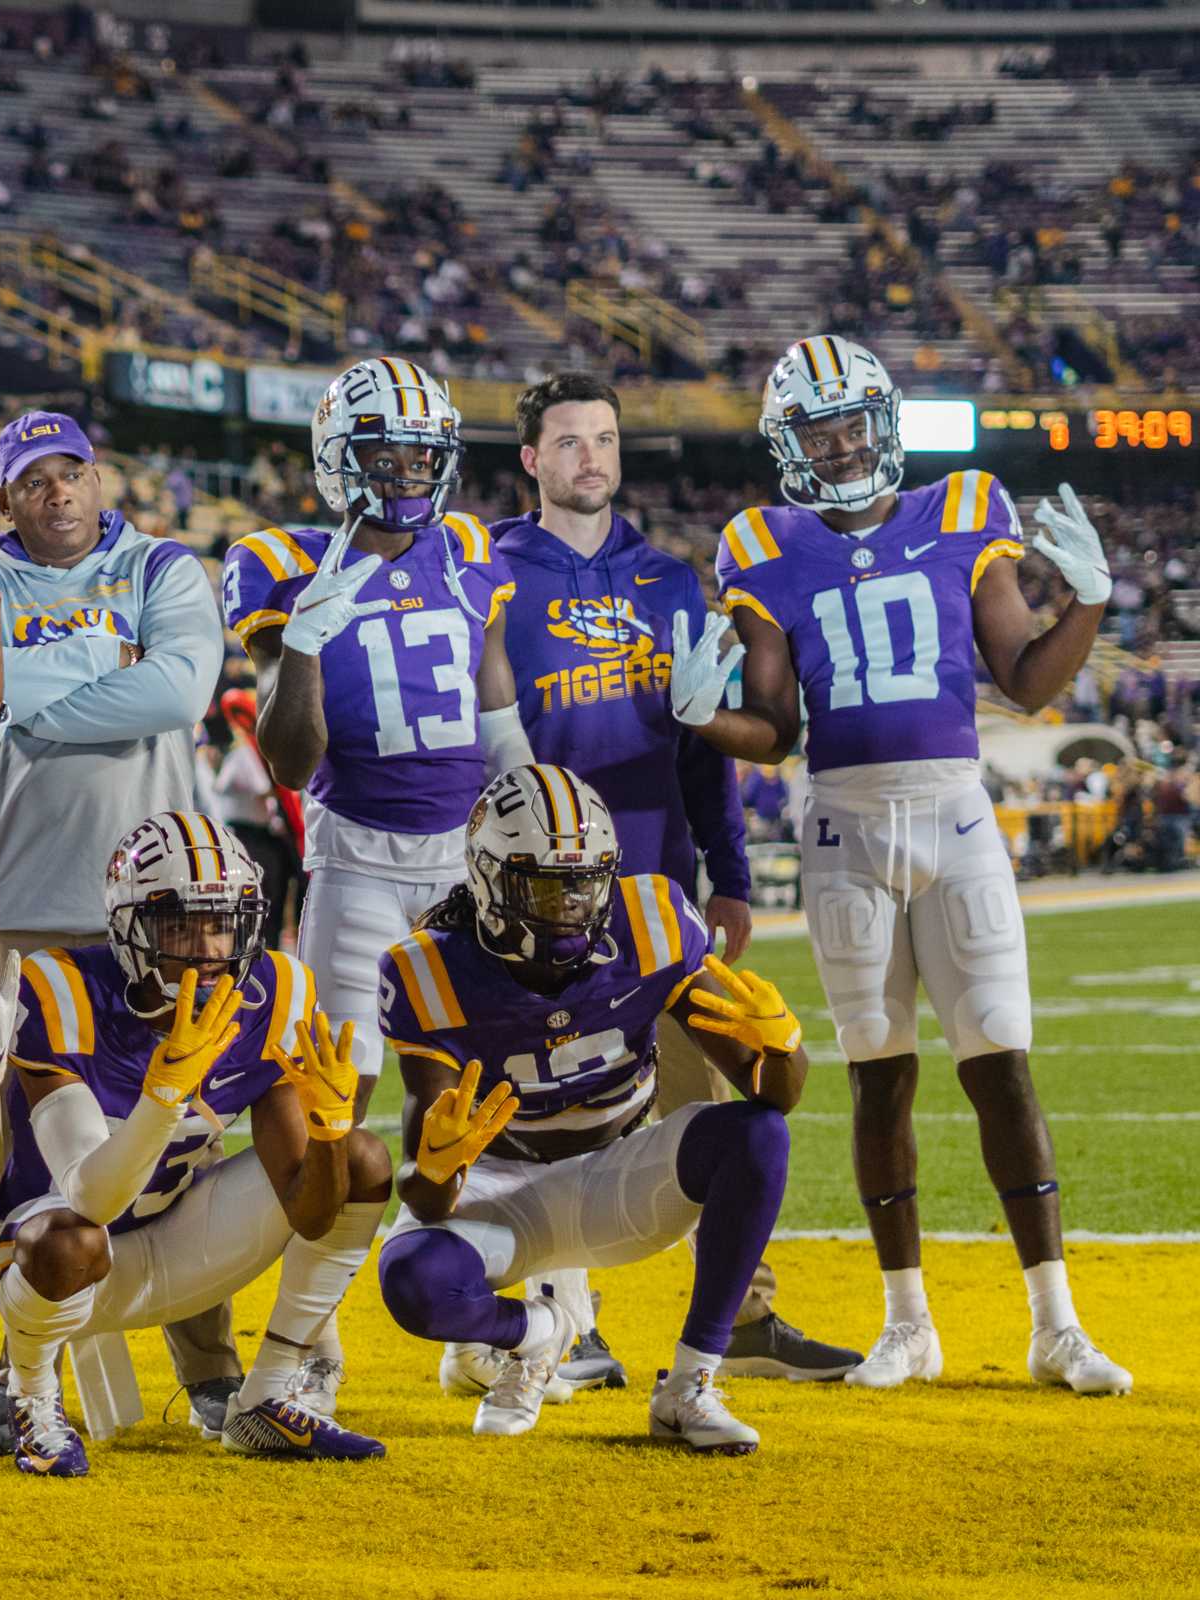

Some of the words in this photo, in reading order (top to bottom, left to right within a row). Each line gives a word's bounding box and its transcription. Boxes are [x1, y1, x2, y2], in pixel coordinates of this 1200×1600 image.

[21, 423, 61, 443] LSU
[403, 419, 428, 429] LSU
[391, 596, 424, 611] LSU
[811, 571, 942, 711] 10
[356, 607, 477, 758] 13
[534, 653, 673, 714] TIGERS
[817, 818, 841, 848] L
[547, 1010, 571, 1029] SEC
